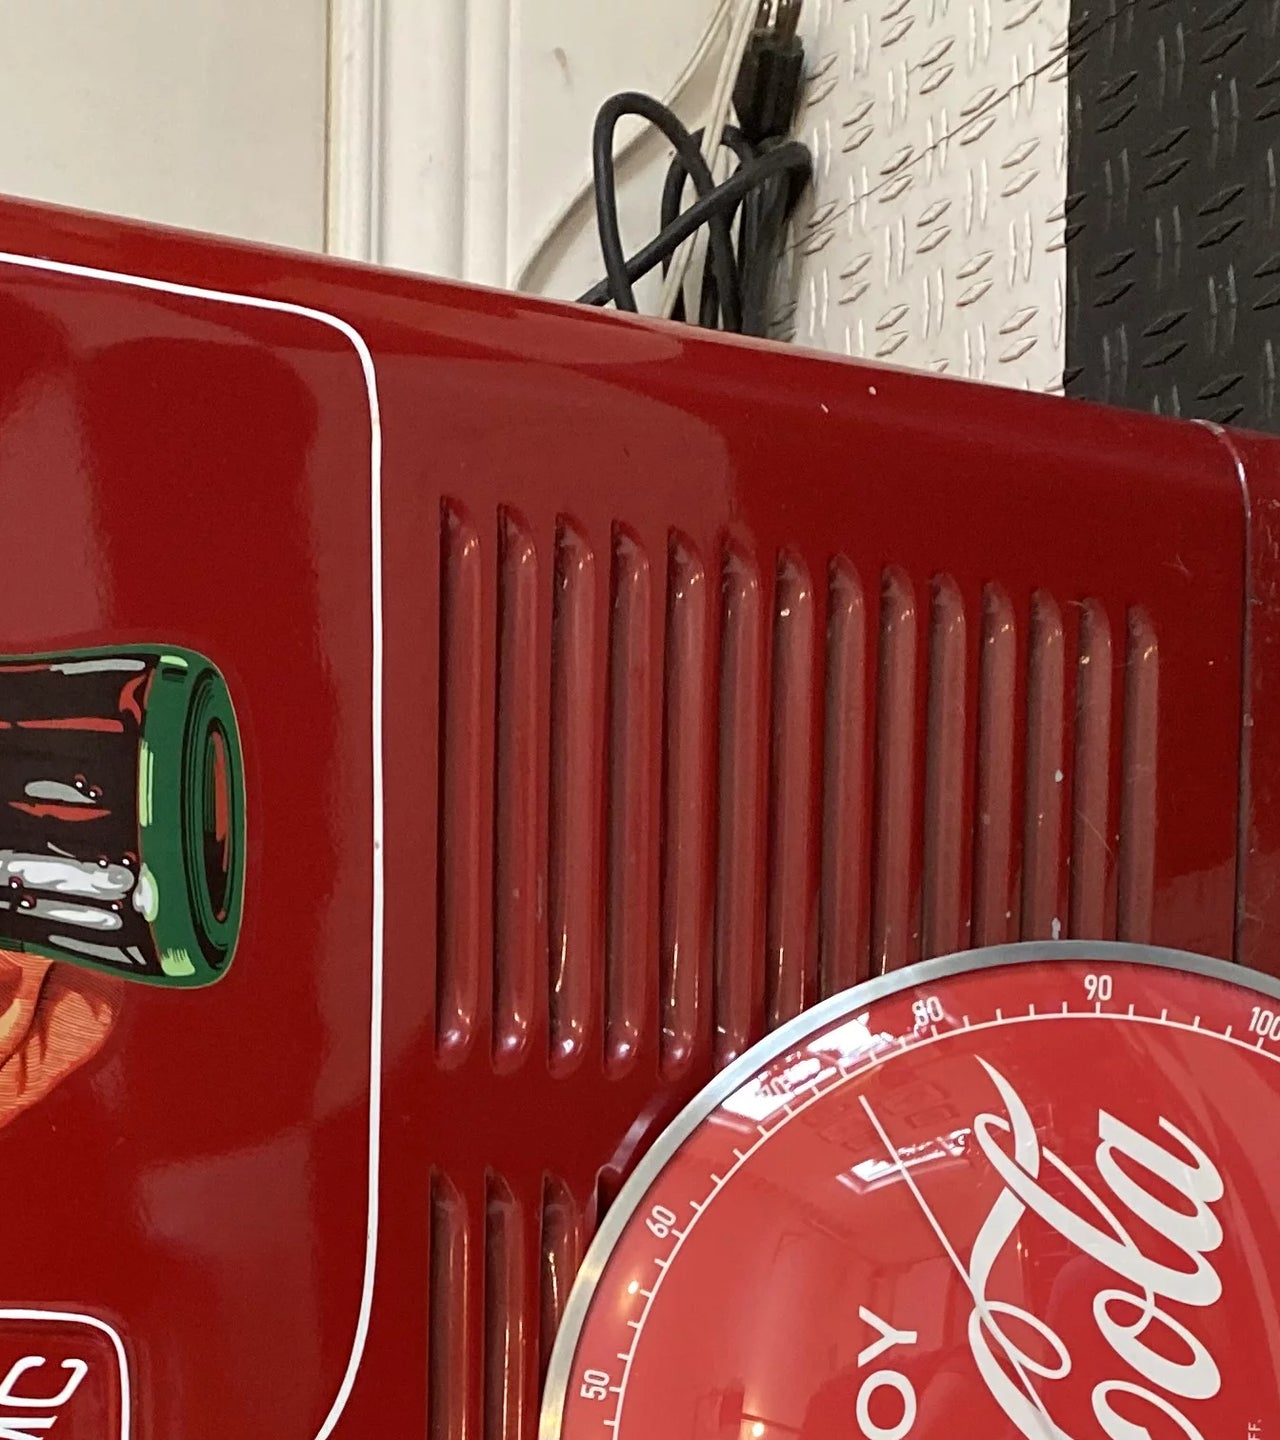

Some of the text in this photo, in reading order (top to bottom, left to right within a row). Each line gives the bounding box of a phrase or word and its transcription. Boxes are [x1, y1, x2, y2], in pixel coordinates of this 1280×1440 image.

[1083, 974, 1112, 1000] 90
[911, 995, 945, 1028] 80
[646, 1206, 676, 1238] 60
[580, 1370, 609, 1400] 50
